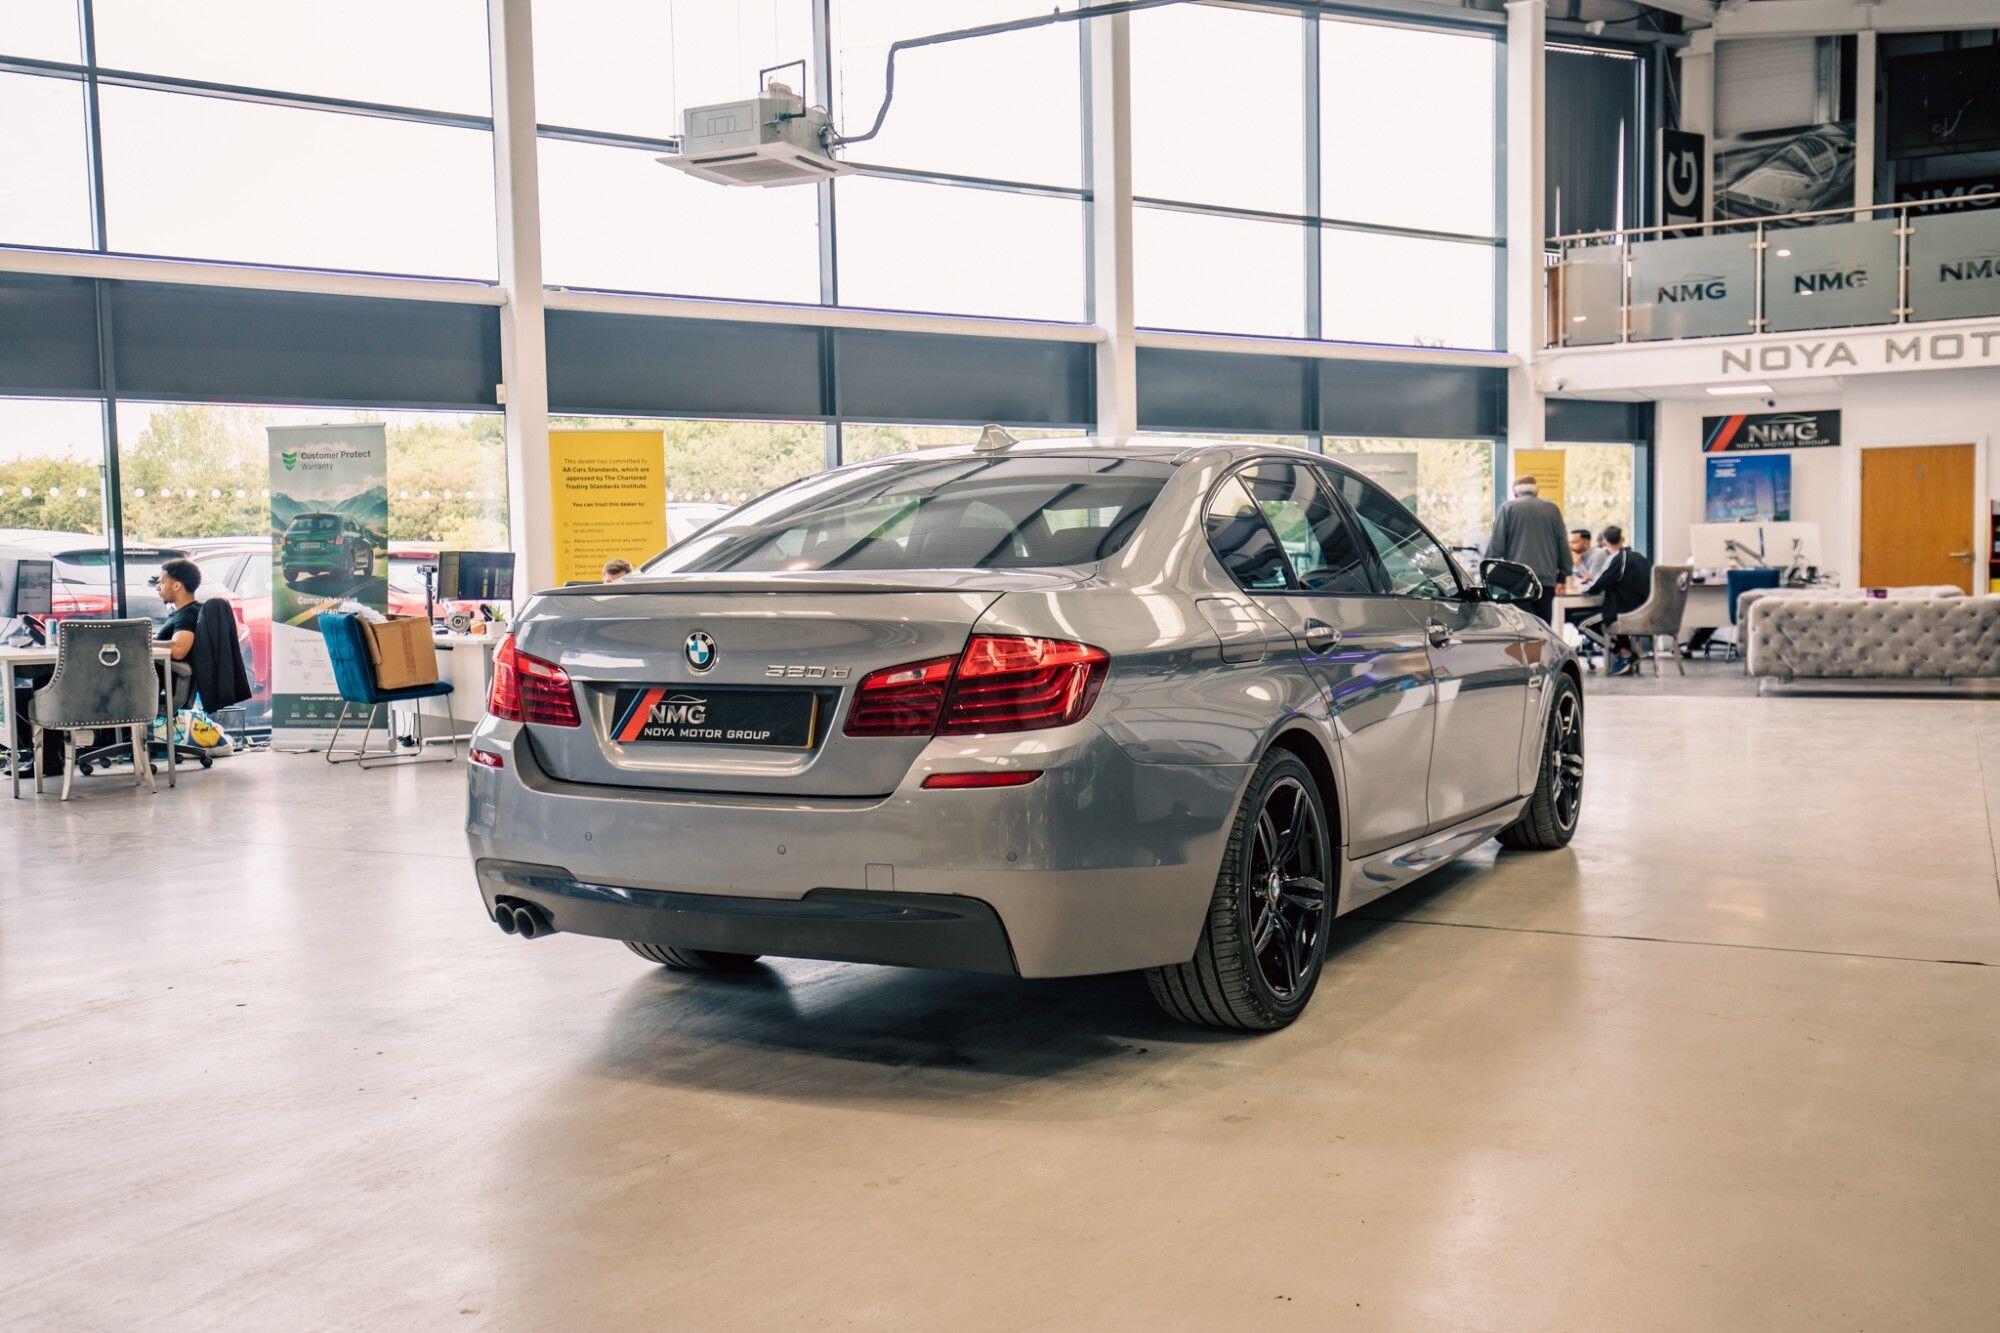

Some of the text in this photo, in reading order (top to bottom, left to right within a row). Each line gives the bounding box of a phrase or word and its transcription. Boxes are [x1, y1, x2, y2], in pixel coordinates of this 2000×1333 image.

[1657, 281, 1727, 304] NMG
[1794, 270, 1868, 294] NMG
[1722, 331, 2000, 374] NOYA MOT
[1748, 422, 1818, 443] NMG
[1797, 439, 1831, 447] GROUP
[301, 450, 372, 460] Customer Protect
[301, 463, 334, 471] Warranty
[647, 704, 706, 725] NMG
[643, 728, 771, 740] NOYA MOTOR GROUP
